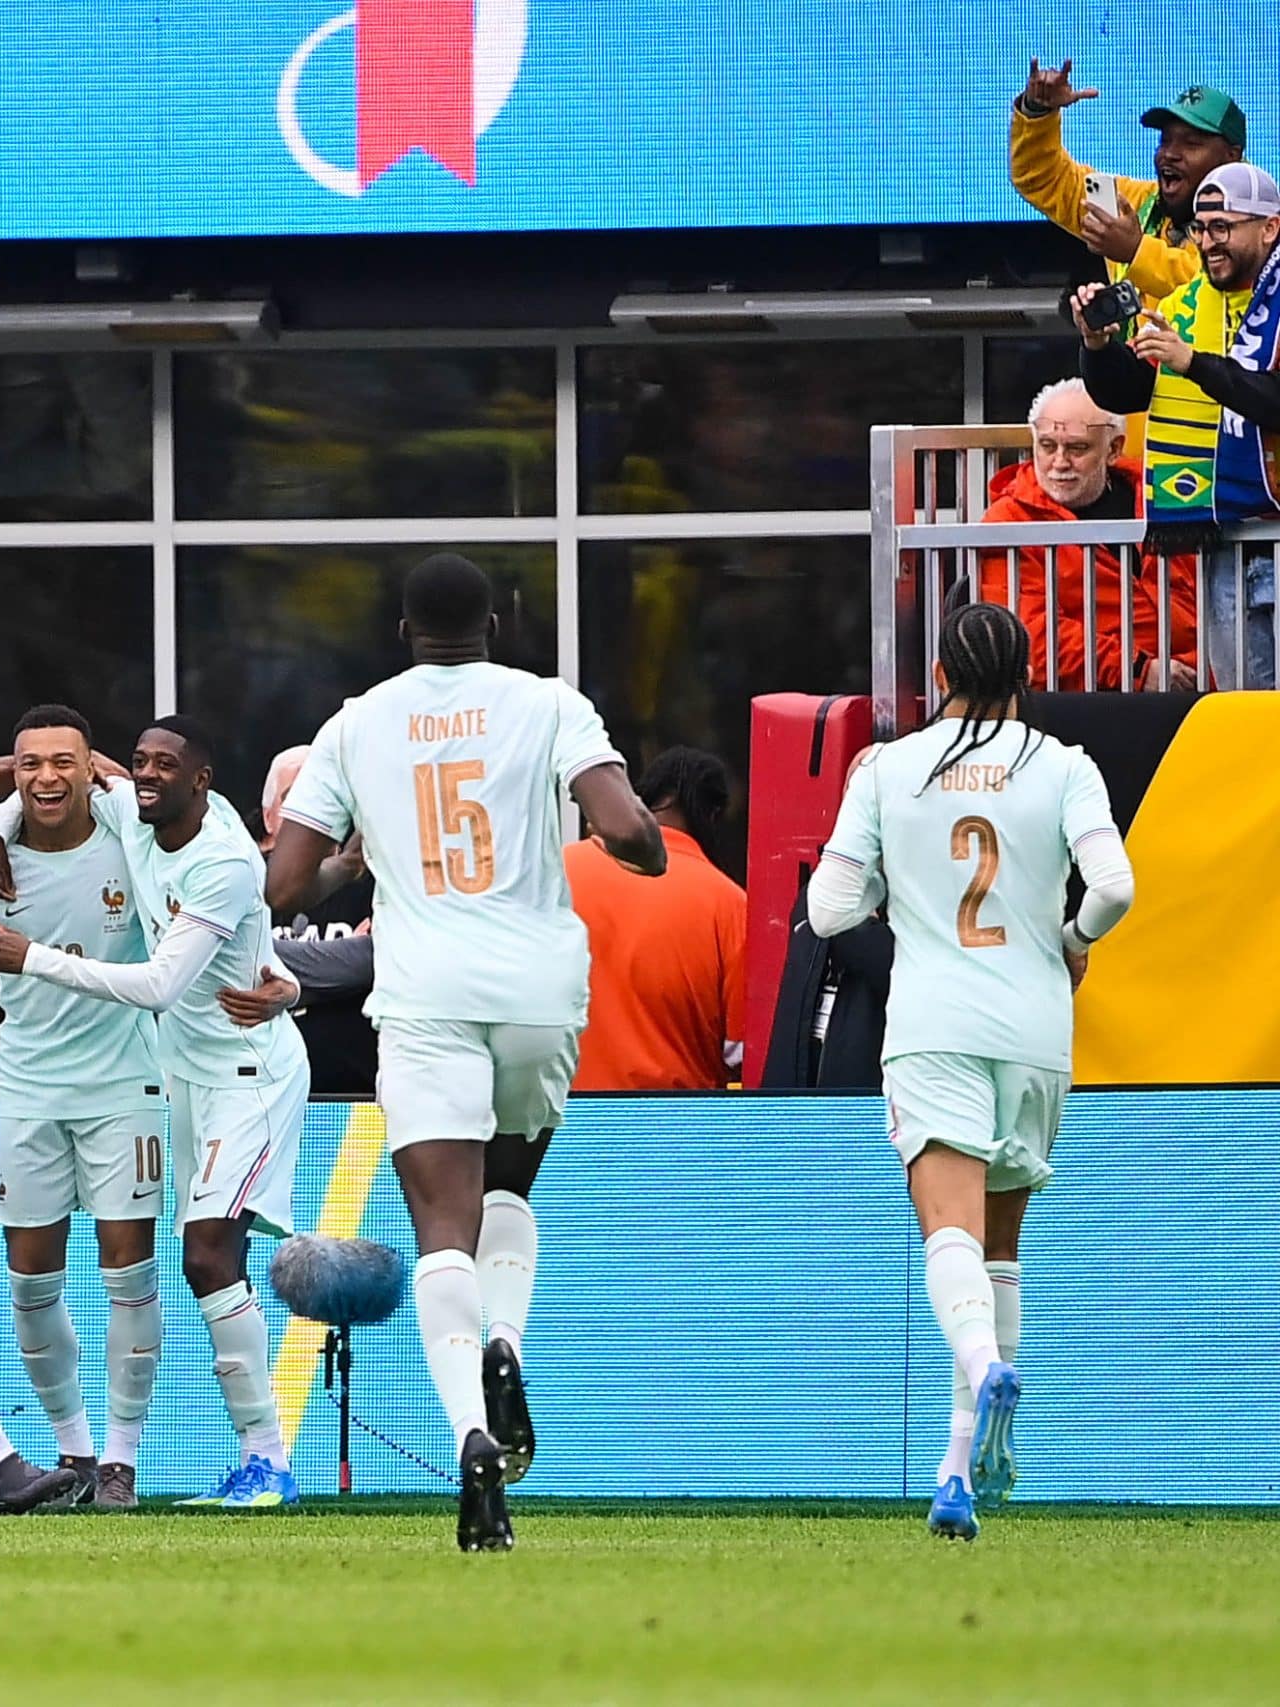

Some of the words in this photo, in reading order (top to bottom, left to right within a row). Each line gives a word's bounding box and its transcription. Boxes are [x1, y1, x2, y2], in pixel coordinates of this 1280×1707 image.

[408, 708, 487, 742] KONATE
[941, 764, 1007, 792] GUSTO
[414, 759, 494, 896] 15
[951, 815, 1006, 947] 2
[135, 1135, 161, 1183] 10
[202, 1139, 222, 1184] 7
